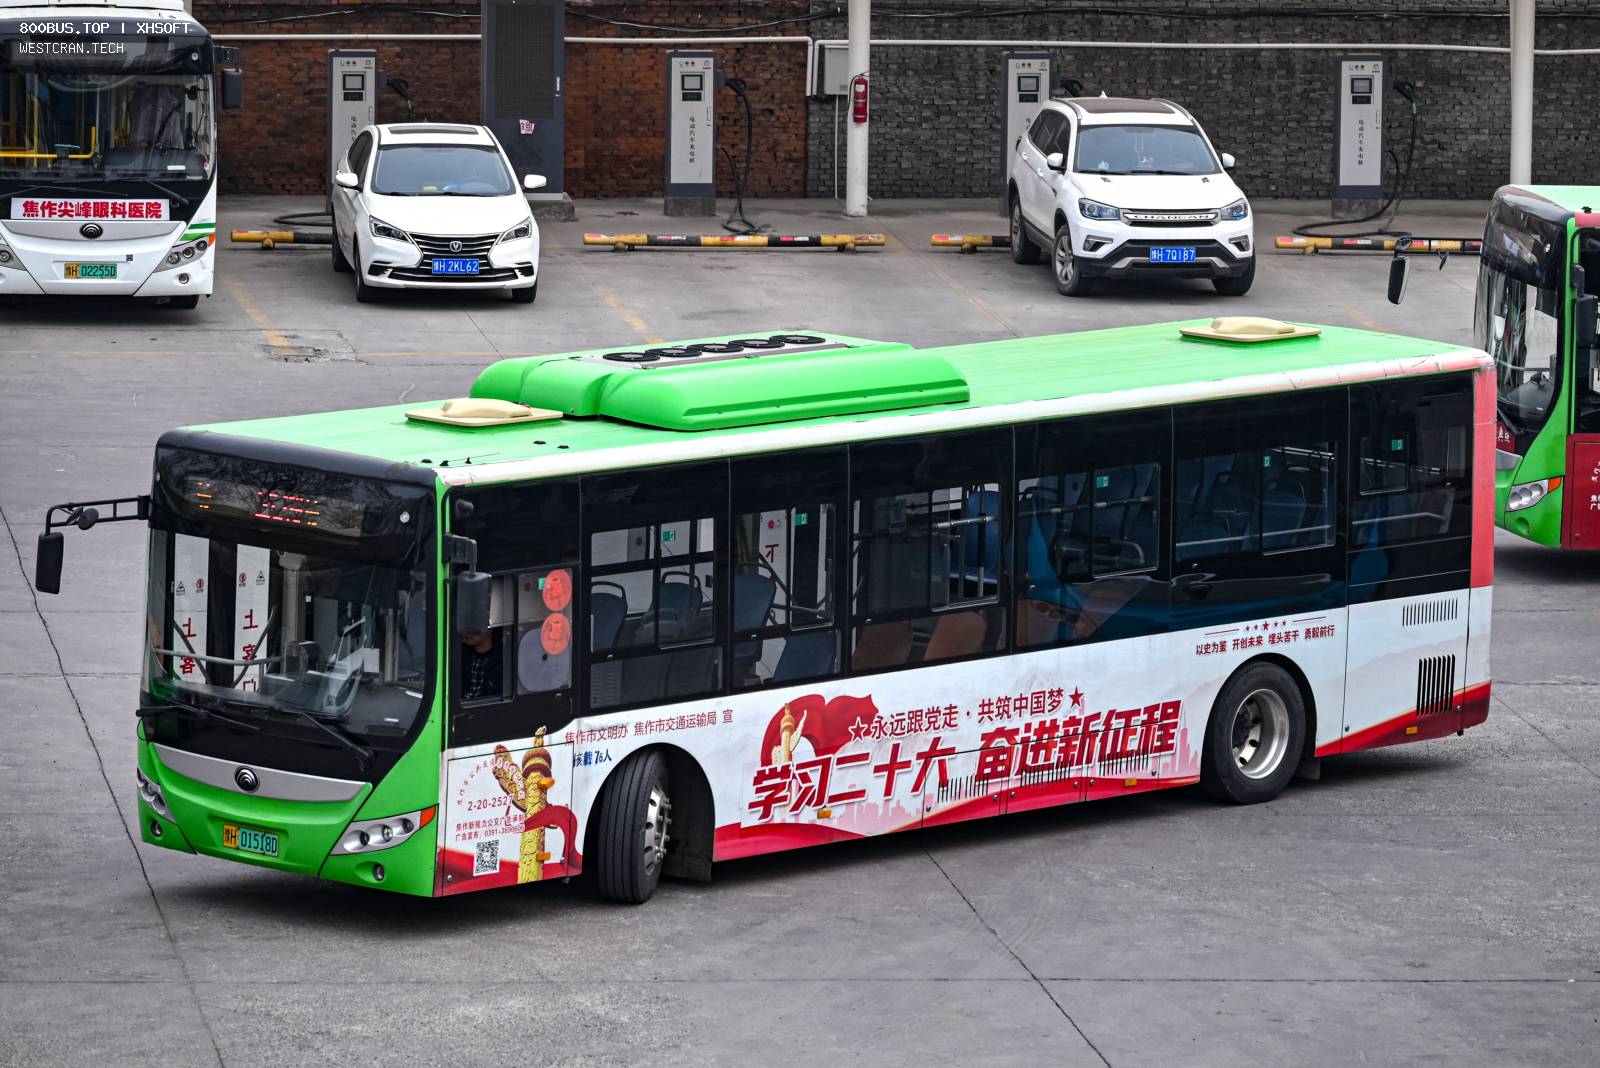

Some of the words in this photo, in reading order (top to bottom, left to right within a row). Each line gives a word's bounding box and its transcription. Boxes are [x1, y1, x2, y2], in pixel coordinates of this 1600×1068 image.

[22, 200, 163, 219] 焦作尖峰眼科医院
[1196, 640, 1228, 656] 以史为鉴
[1231, 635, 1264, 651] 开创未来
[1268, 630, 1300, 645] 埋头苦干
[1304, 624, 1335, 640] 勇毅前行
[565, 724, 629, 746] 焦作市文明办
[634, 711, 717, 737] 焦作市交通运输局
[722, 708, 734, 724] 宣
[747, 737, 957, 821] 学习二十大
[974, 699, 1183, 783] 奋进新征程
